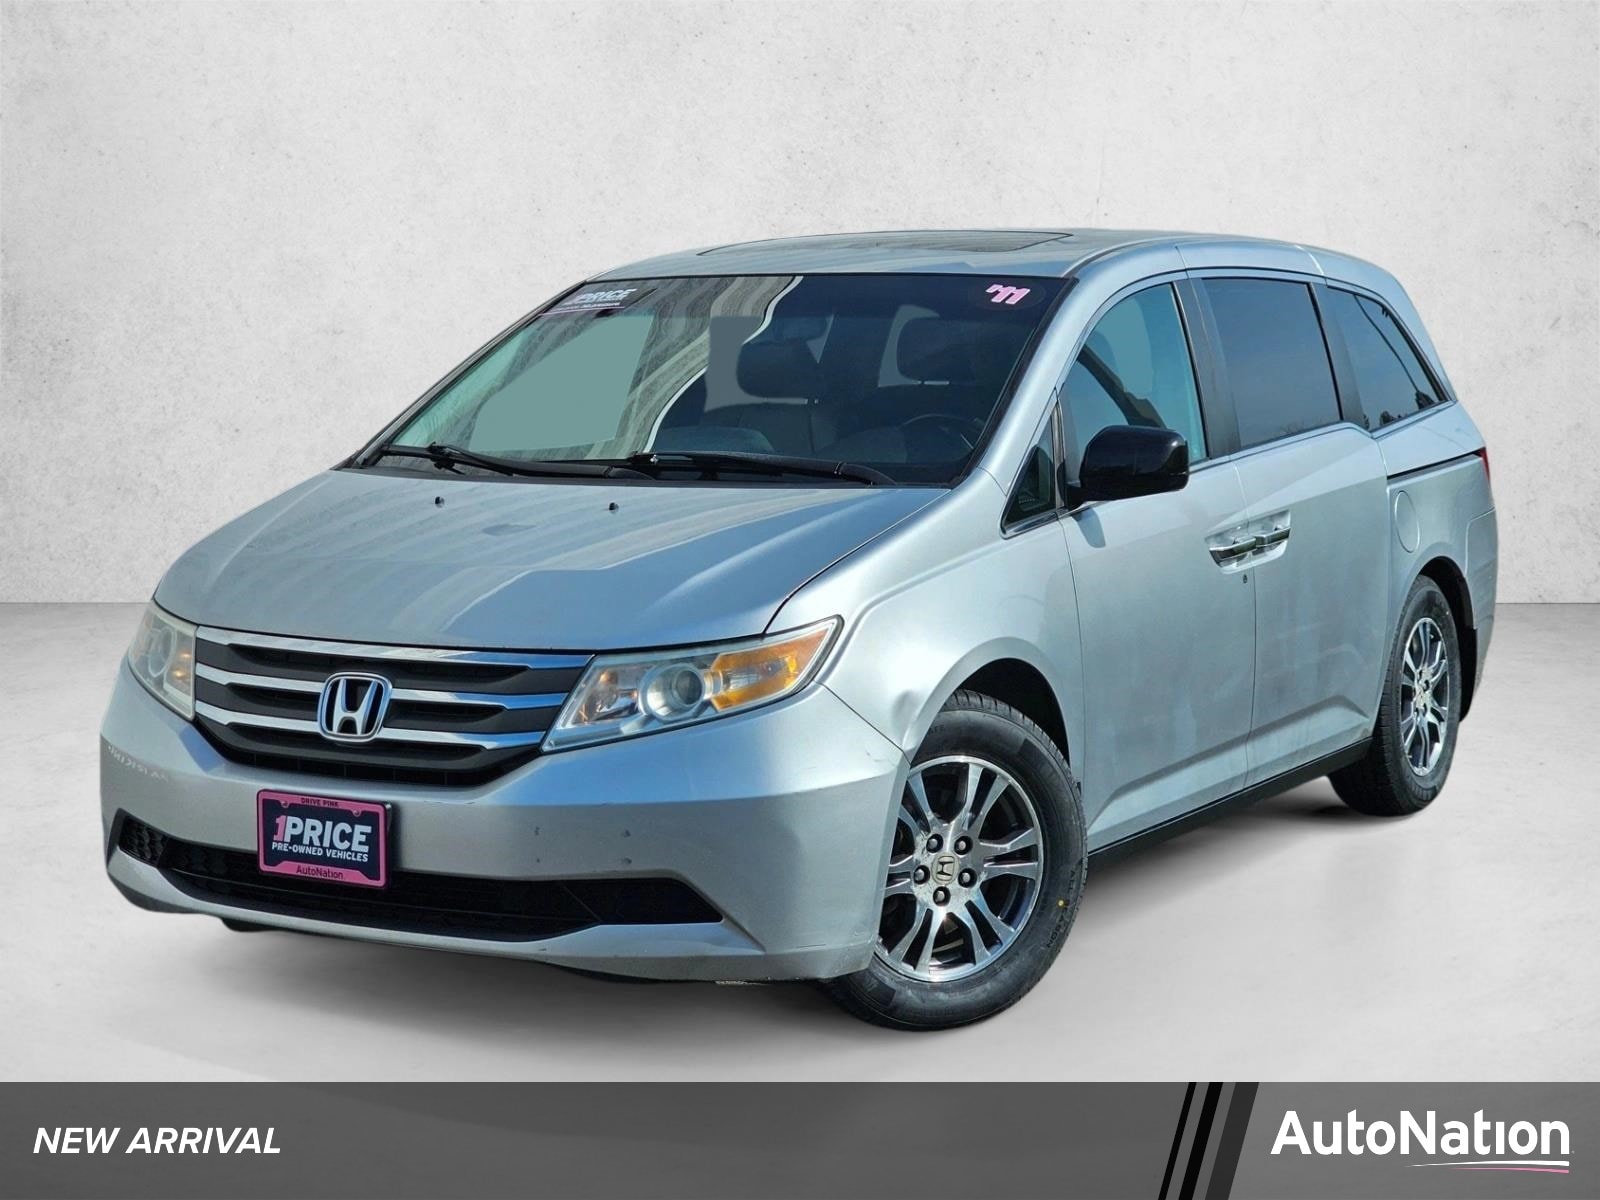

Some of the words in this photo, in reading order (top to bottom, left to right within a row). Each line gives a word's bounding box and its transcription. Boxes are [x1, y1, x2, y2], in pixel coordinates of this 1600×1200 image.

[300, 797, 321, 806] DRIVE
[322, 800, 339, 808] PINK
[273, 815, 372, 853] 1PRICE
[271, 842, 323, 856] PRE-OWNED
[326, 849, 369, 863] VEHICLES
[295, 865, 344, 880] AutoNation
